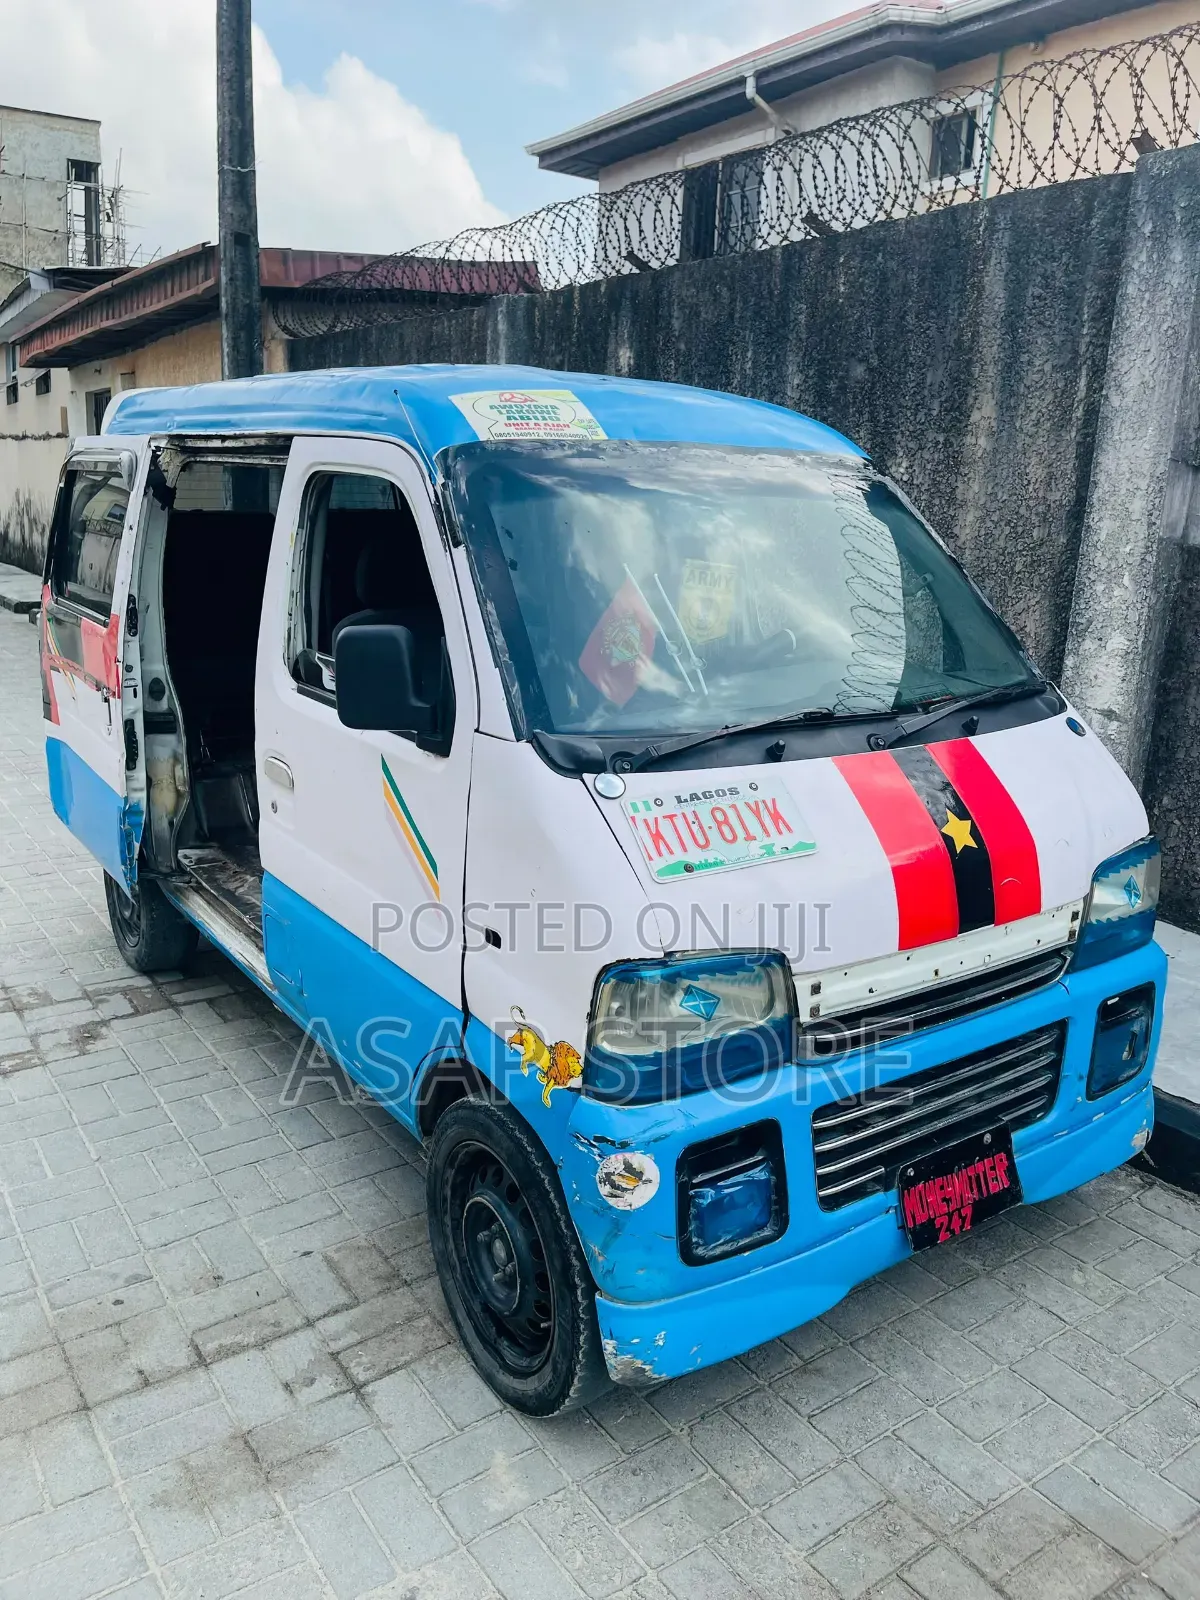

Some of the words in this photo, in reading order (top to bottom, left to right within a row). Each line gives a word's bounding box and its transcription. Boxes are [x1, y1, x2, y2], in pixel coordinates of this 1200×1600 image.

[685, 569, 735, 589] ARMY
[674, 787, 740, 804] LAGOS
[935, 1204, 973, 1243] 247
